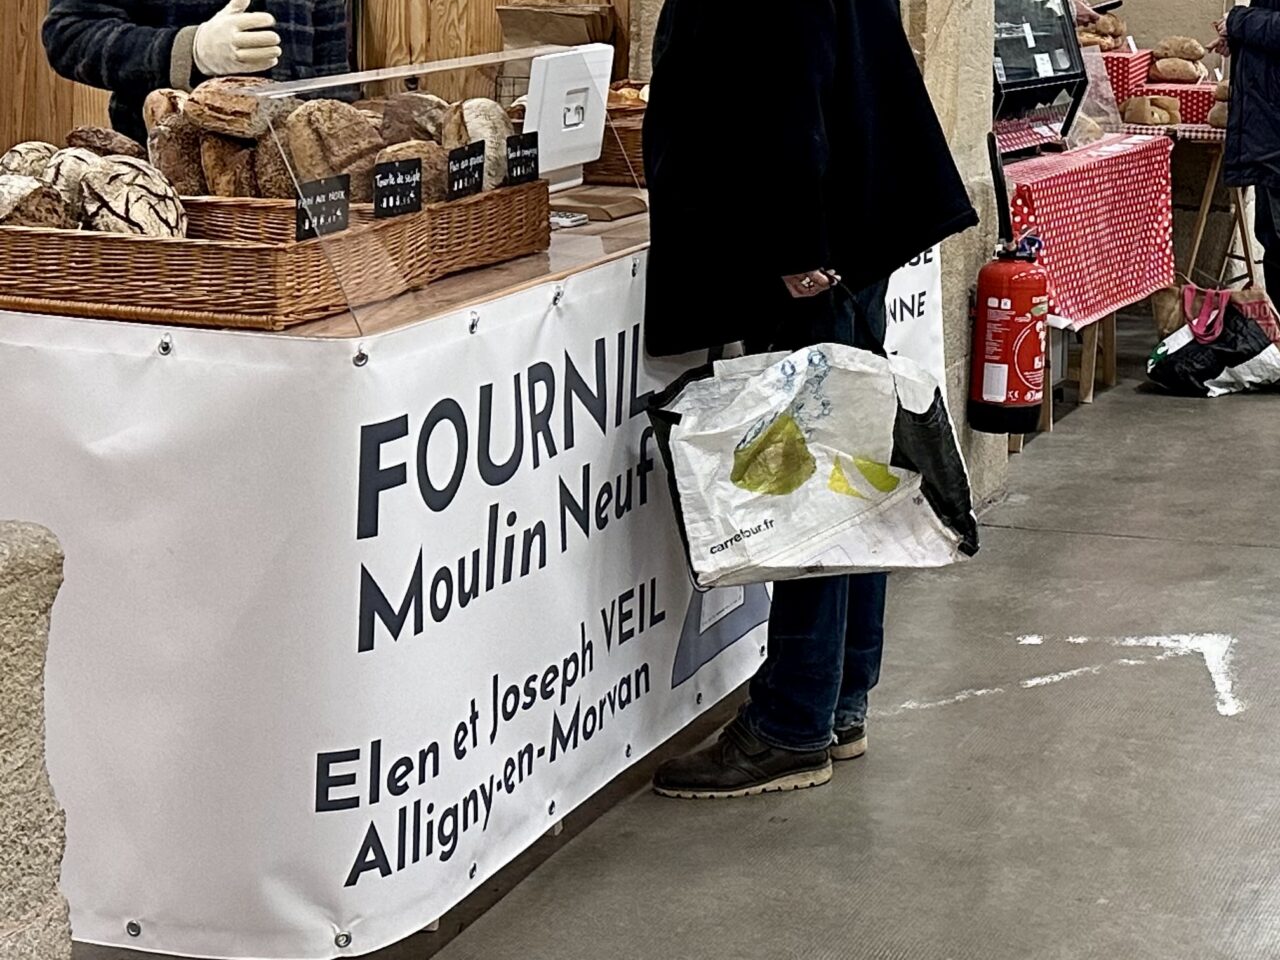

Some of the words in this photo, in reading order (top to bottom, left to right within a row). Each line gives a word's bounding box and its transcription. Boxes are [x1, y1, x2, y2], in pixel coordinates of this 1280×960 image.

[356, 323, 655, 540] FOURNIL
[357, 503, 547, 653] Moulin
[558, 426, 655, 554] Neuf
[315, 739, 440, 813] Elen
[453, 698, 480, 760] et
[489, 622, 594, 745] Joseph
[600, 577, 666, 653] VEIL
[343, 661, 651, 888] Alligny-en-Morvan
